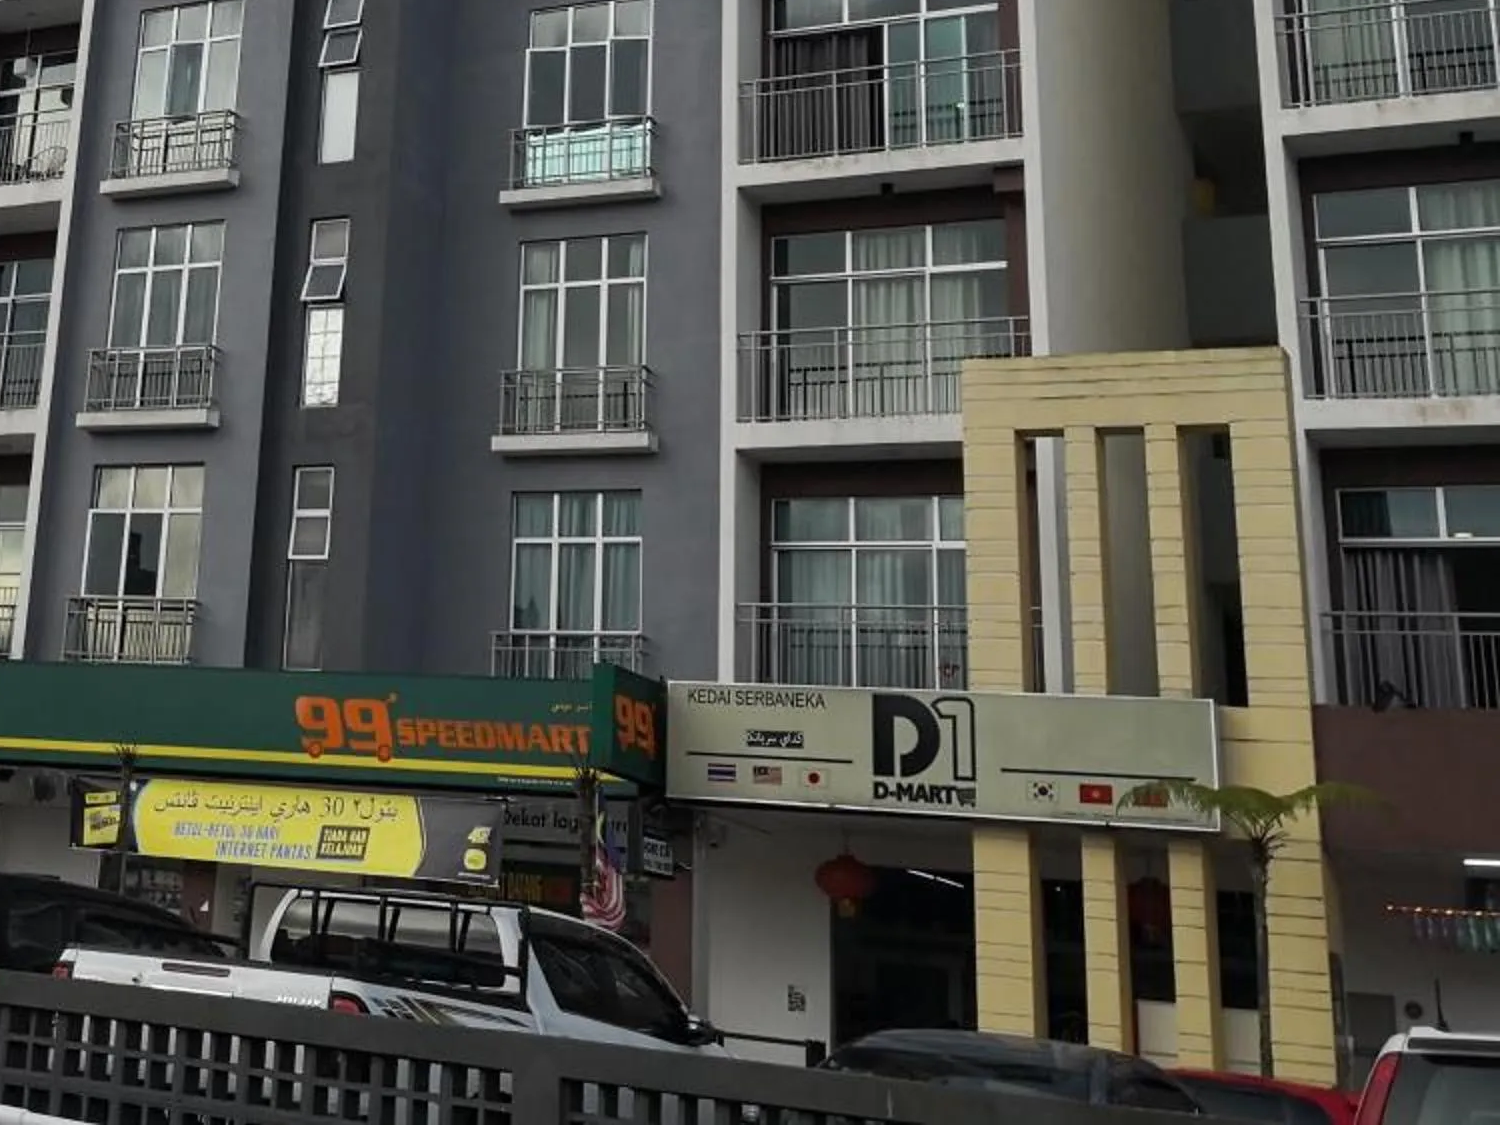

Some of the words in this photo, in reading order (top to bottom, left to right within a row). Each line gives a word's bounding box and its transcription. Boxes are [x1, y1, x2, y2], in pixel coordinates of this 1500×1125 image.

[687, 688, 731, 706] KEDAI
[735, 690, 827, 709] SERBANEKA
[295, 694, 393, 762] 99
[397, 716, 592, 756] SPEEDMART
[613, 694, 656, 757] 99
[873, 781, 958, 803] D-MART
[320, 796, 345, 817] 30
[215, 840, 266, 859] INTERNET
[269, 842, 313, 860] PANTAS
